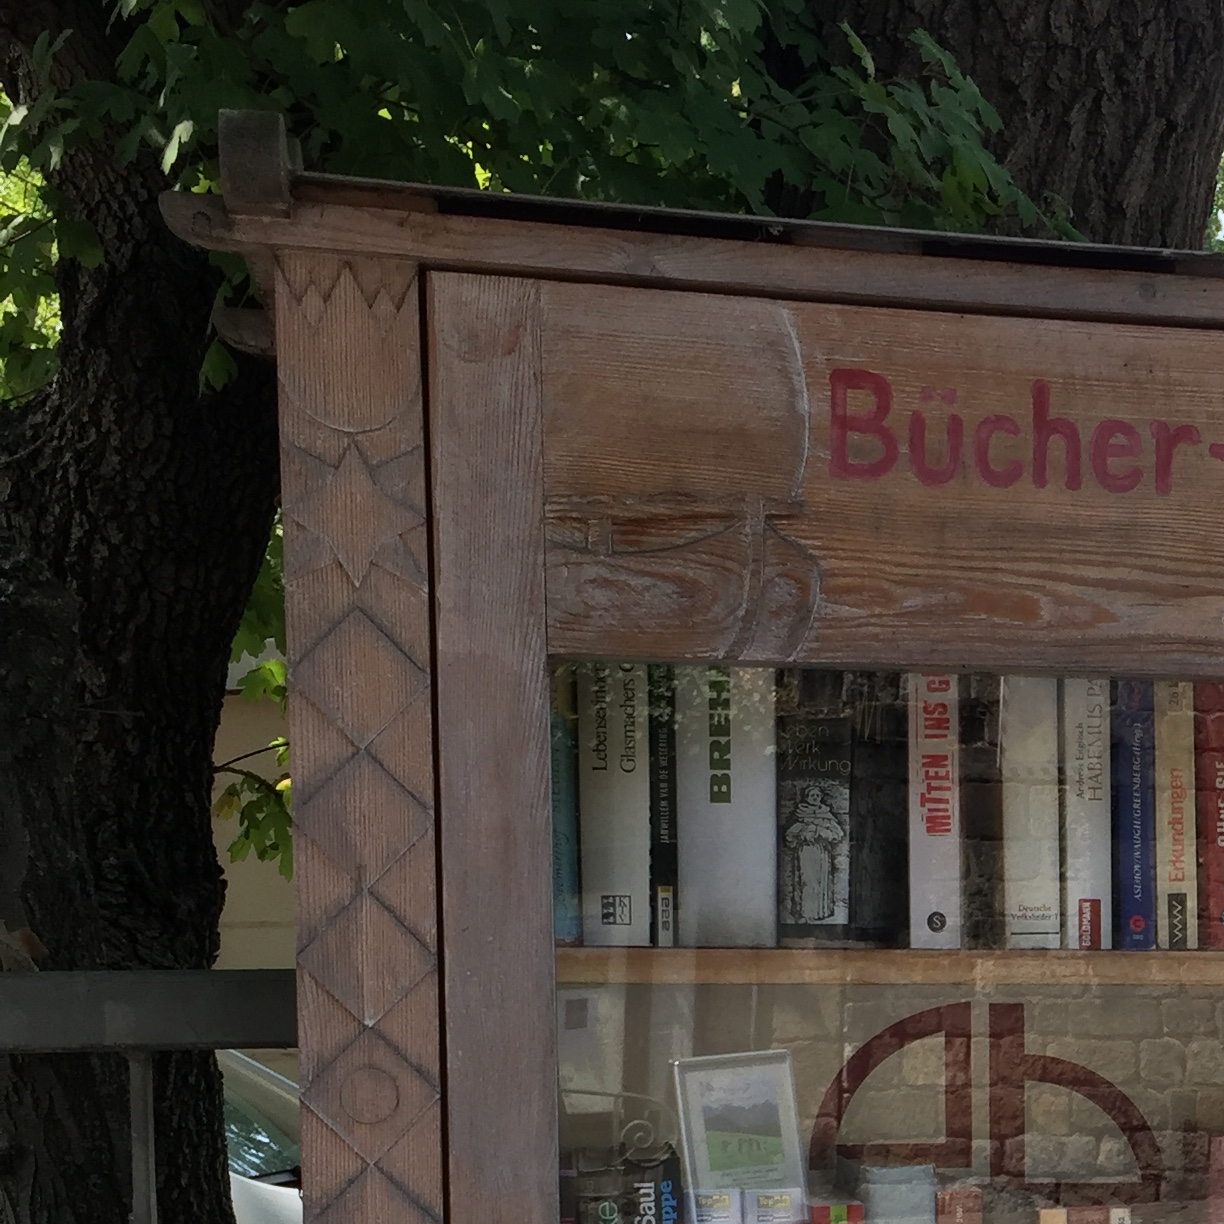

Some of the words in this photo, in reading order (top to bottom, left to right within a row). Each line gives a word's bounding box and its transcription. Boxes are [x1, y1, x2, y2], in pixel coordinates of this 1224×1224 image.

[618, 678, 636, 774] Glasmachers
[923, 702, 951, 740] INS
[1086, 704, 1102, 802] HABEMUS
[920, 753, 952, 837] MITTEN
[1168, 767, 1186, 883] Erkundungen
